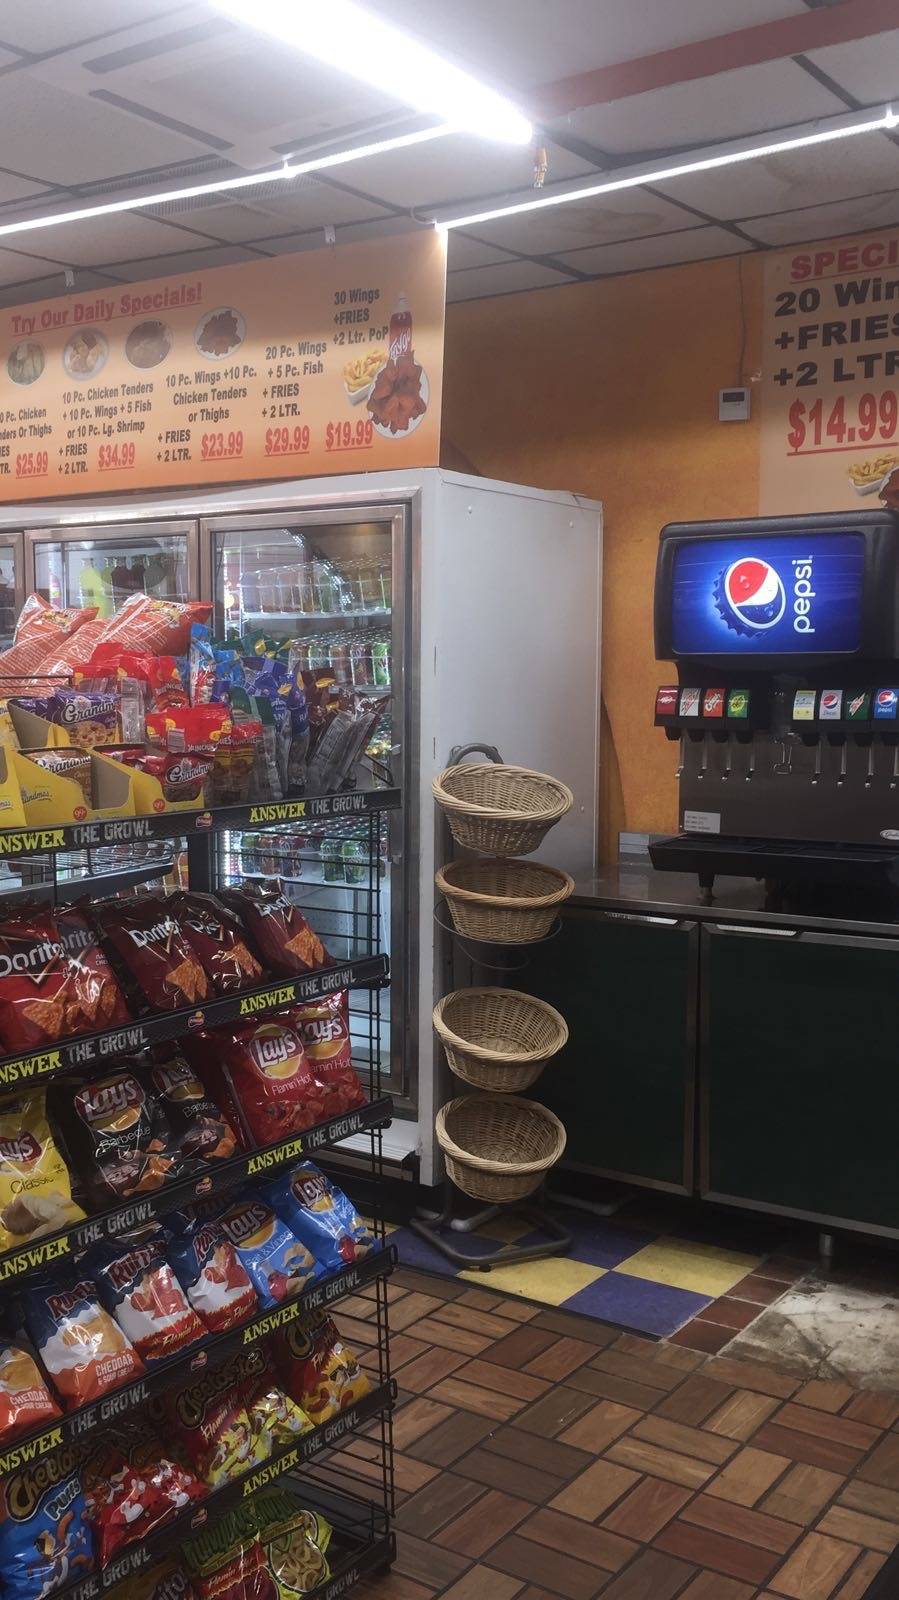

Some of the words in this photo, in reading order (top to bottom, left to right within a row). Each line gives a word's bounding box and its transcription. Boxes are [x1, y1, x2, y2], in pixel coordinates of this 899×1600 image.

[12, 315, 36, 336] Try
[41, 309, 68, 329] Our
[74, 299, 115, 325] Daily
[120, 282, 202, 316] Specials!
[334, 290, 346, 306] 30
[349, 288, 380, 304] Wings
[775, 288, 820, 317] 20
[334, 308, 370, 326] +FRIES
[333, 330, 345, 346] +2
[348, 328, 366, 345] Ltr.
[265, 346, 278, 360] 20
[280, 344, 296, 358] Pc.
[298, 341, 328, 358] Wings
[165, 375, 176, 388] 10
[178, 374, 192, 386] Pc.
[194, 370, 220, 386] Wings
[242, 364, 258, 378] Pc.
[276, 365, 282, 378] 5
[285, 363, 300, 377] Pc.
[303, 361, 324, 376] Fish
[774, 361, 818, 387] +2
[62, 392, 73, 404] 10
[74, 390, 86, 402] Pc.
[87, 387, 120, 402] Chicken
[121, 382, 154, 398] Tenders
[173, 391, 208, 406] Chicken
[211, 386, 248, 401] Tenders
[270, 382, 300, 399] FRIES
[6, 411, 16, 423] Pc.
[18, 407, 47, 422] Chicken
[69, 408, 79, 420] 10
[80, 406, 94, 420] Pc.
[94, 404, 118, 420] Wings
[127, 402, 132, 412] 5
[134, 400, 152, 412] Fish
[188, 412, 198, 422] or
[200, 407, 230, 423] Thighs
[270, 405, 276, 418] 2
[278, 403, 300, 418] LTR.
[788, 390, 898, 453] $14.99
[18, 426, 28, 438] Or
[29, 423, 52, 440] Thighs
[67, 429, 76, 440] or
[77, 426, 87, 438] 10
[88, 424, 100, 436] Pc.
[102, 423, 115, 437] Lg.
[117, 420, 146, 436] Shrimp
[165, 429, 191, 444] FRIES
[265, 425, 310, 455] $29.99
[326, 419, 374, 450] $19.99
[66, 443, 88, 457] FRIES
[98, 442, 136, 468] $34.99
[164, 450, 170, 462] 2
[172, 448, 192, 461] LTR.
[201, 430, 244, 458] $23.99
[16, 451, 48, 476] $25.99
[64, 462, 70, 475] 2
[72, 460, 88, 474] LTR.
[792, 557, 816, 634] pepsi
[250, 802, 306, 822] ANSWER
[311, 798, 332, 815] THE
[332, 794, 368, 812] GROWL
[73, 824, 100, 844] THE
[104, 819, 154, 840] GROWL
[240, 984, 296, 1016] ANSWER
[300, 978, 319, 997] THE
[321, 970, 357, 990] GROWL
[67, 1040, 96, 1062] THE
[100, 1027, 150, 1056] GROWL
[256, 1032, 298, 1068] Lay's
[98, 1126, 152, 1152] Barbecue
[247, 1139, 304, 1176] ANSWER
[306, 1133, 326, 1150] THE
[328, 1115, 364, 1140] GROWL
[75, 1224, 104, 1246] THE
[107, 1202, 157, 1232] GROWL
[244, 1302, 300, 1345] ANSWER
[303, 1293, 322, 1310] THE
[325, 1272, 360, 1299] GROWL
[96, 1354, 134, 1377] CHEDDAR
[70, 1408, 98, 1436] THE
[101, 1384, 151, 1420] GROWL
[243, 1449, 299, 1497] ANSWER
[303, 1438, 323, 1458] THE
[325, 1411, 360, 1441] GROWL
[102, 1548, 152, 1587] GROWL
